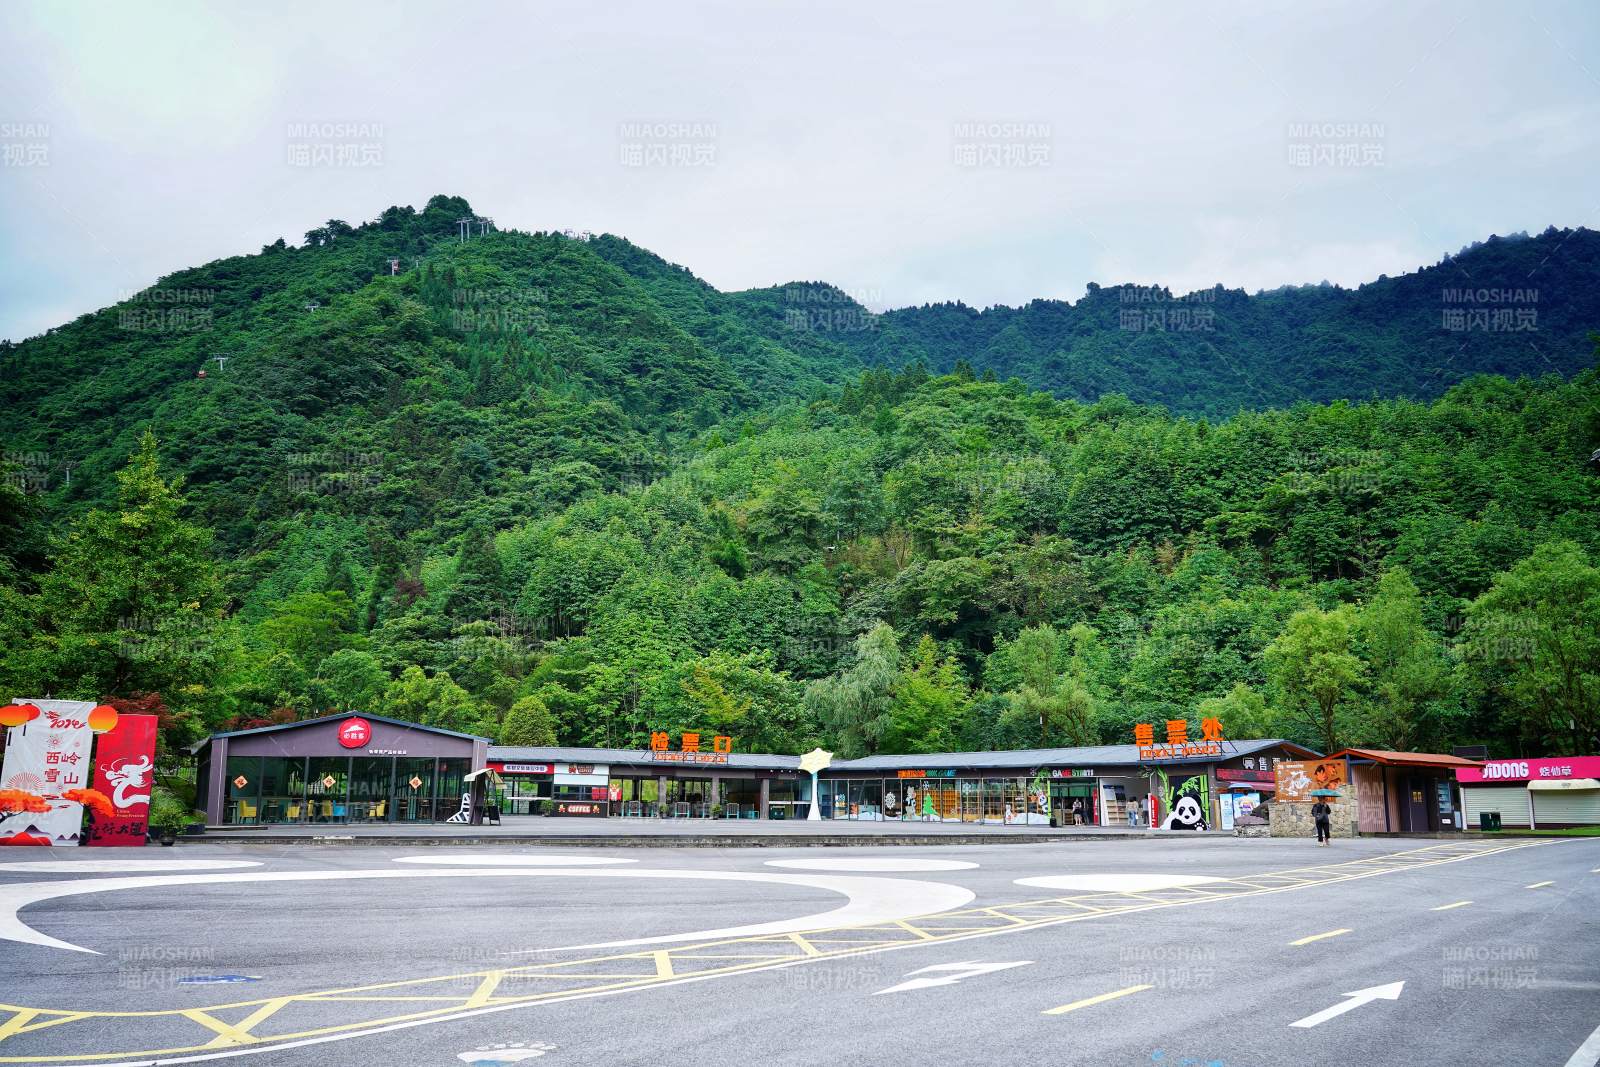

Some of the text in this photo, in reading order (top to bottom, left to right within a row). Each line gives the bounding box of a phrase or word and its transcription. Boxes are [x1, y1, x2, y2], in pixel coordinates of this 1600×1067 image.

[343, 732, 365, 740] 必胜客
[1134, 717, 1225, 747] 售票处
[650, 731, 732, 753] 检票口
[46, 751, 82, 766] 西岭
[44, 768, 79, 785] 雪山
[1539, 765, 1573, 777] 烧仙草
[568, 804, 591, 813] COFFEE
